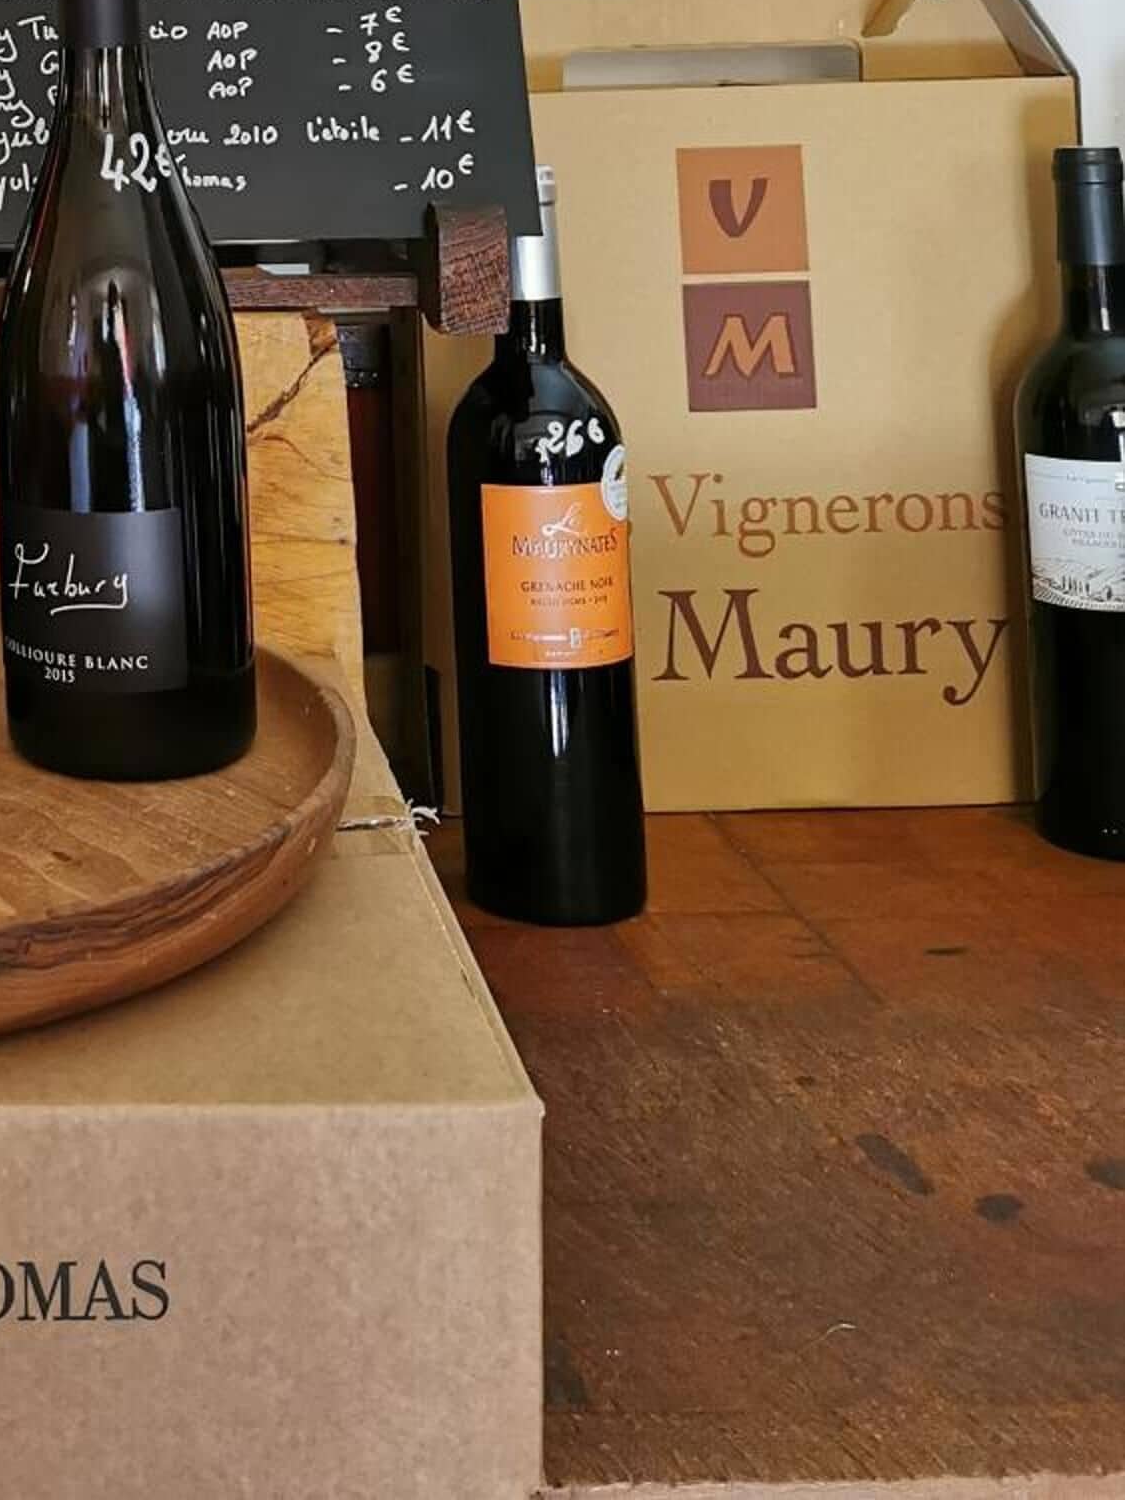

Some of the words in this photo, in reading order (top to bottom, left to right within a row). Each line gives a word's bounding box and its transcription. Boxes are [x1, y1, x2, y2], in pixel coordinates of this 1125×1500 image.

[207, 21, 248, 40] AOP
[207, 48, 257, 72] AOP
[224, 124, 277, 145] 2010
[180, 162, 247, 192] homas
[708, 178, 769, 238] V
[703, 313, 801, 379] M
[649, 472, 1007, 558] Vignerons
[84, 655, 149, 670] BLANC
[652, 589, 1008, 706] Maury
